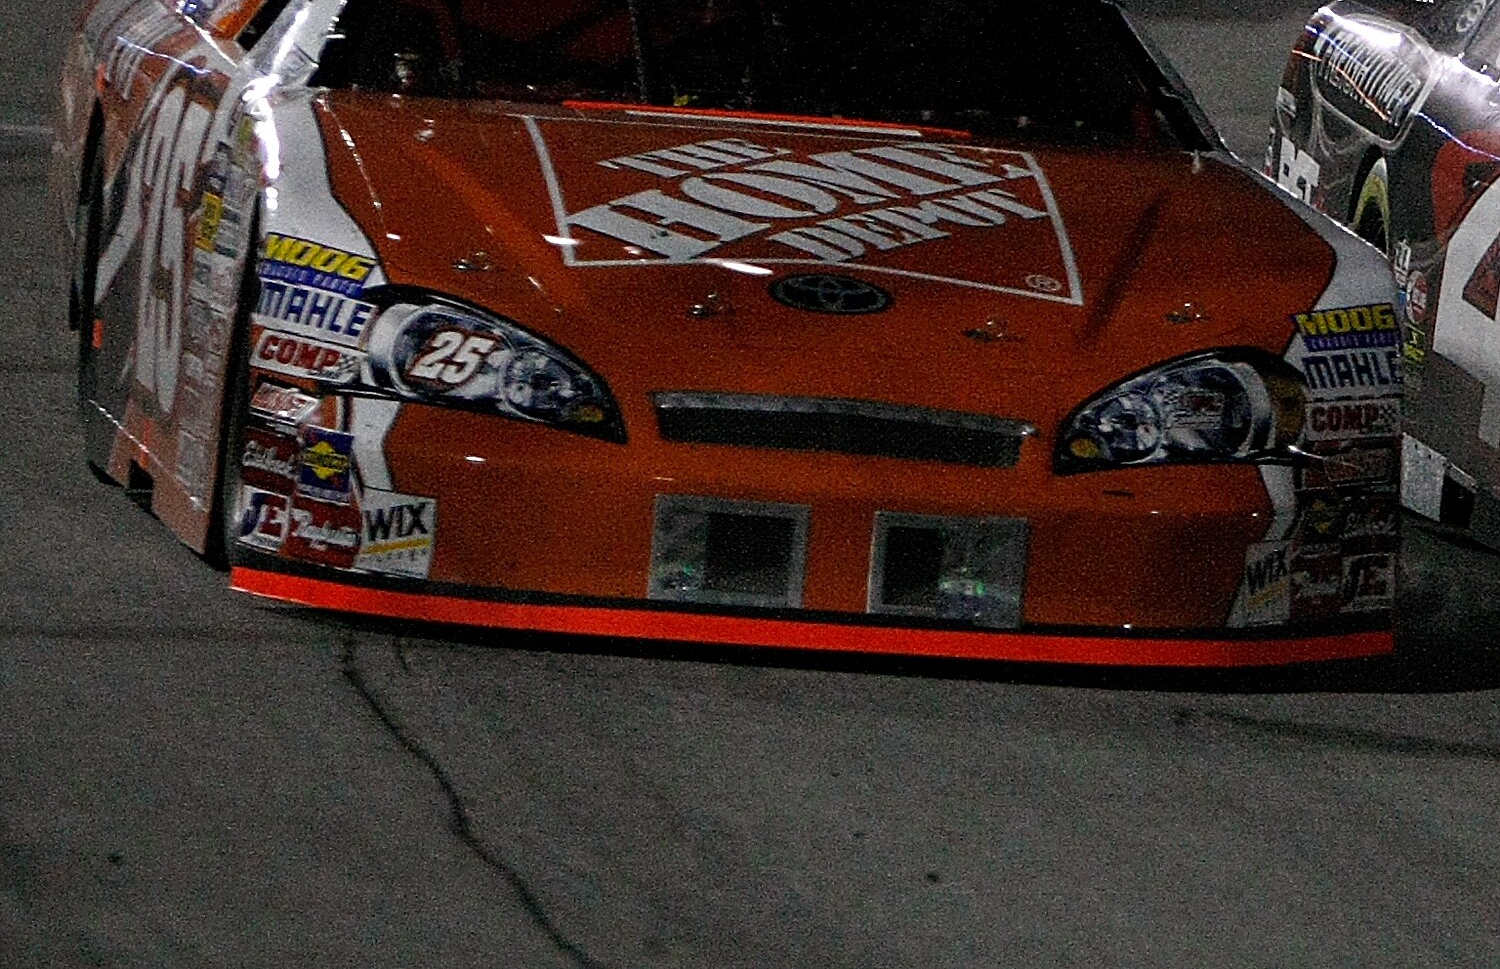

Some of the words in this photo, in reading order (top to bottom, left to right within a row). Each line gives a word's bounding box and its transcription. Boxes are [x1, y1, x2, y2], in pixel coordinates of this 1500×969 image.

[597, 137, 794, 179] THE
[566, 145, 1040, 262] HOME
[765, 189, 1051, 263] DEPOT
[263, 234, 377, 281] MOOG
[259, 282, 372, 337] MAHLE
[1295, 305, 1398, 336] MOOG
[259, 335, 340, 370] COMP
[409, 330, 494, 385] 25
[1301, 350, 1404, 390] MAHLE
[1311, 404, 1379, 433] COMP
[365, 501, 429, 542] WIX
